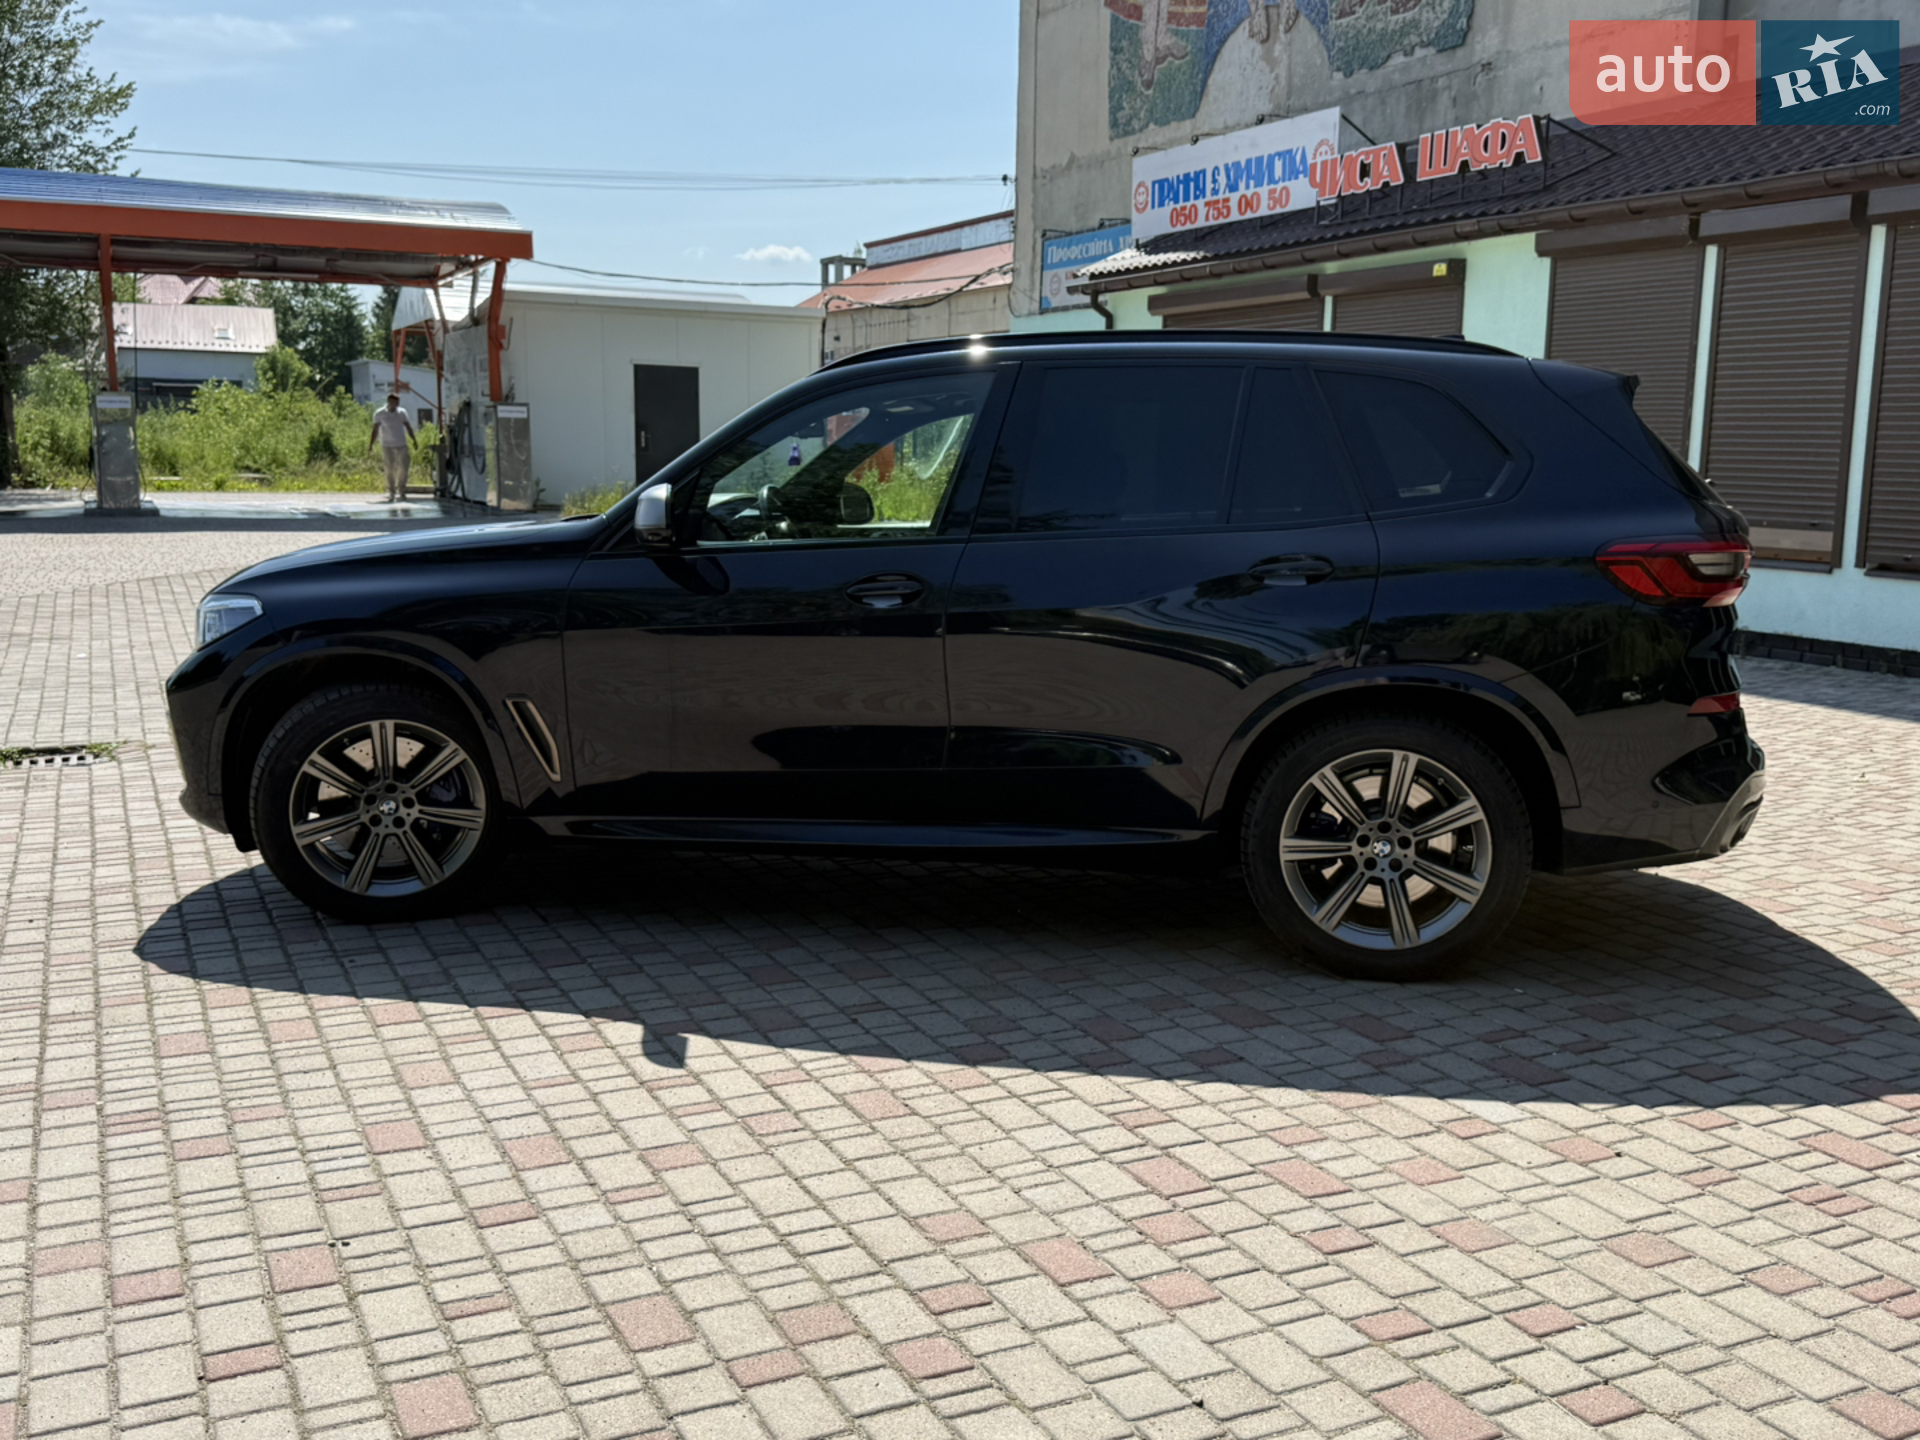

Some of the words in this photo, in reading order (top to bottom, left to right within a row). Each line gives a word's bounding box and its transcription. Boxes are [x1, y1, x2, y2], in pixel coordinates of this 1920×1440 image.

[1308, 141, 1405, 200] ЧИСТА
[1416, 113, 1543, 182] ШАФА
[1151, 168, 1207, 210] ПРАННЯ
[1169, 203, 1198, 228] 050
[1204, 196, 1231, 222] 755
[1237, 191, 1262, 217] 00
[1267, 185, 1291, 212] 50
